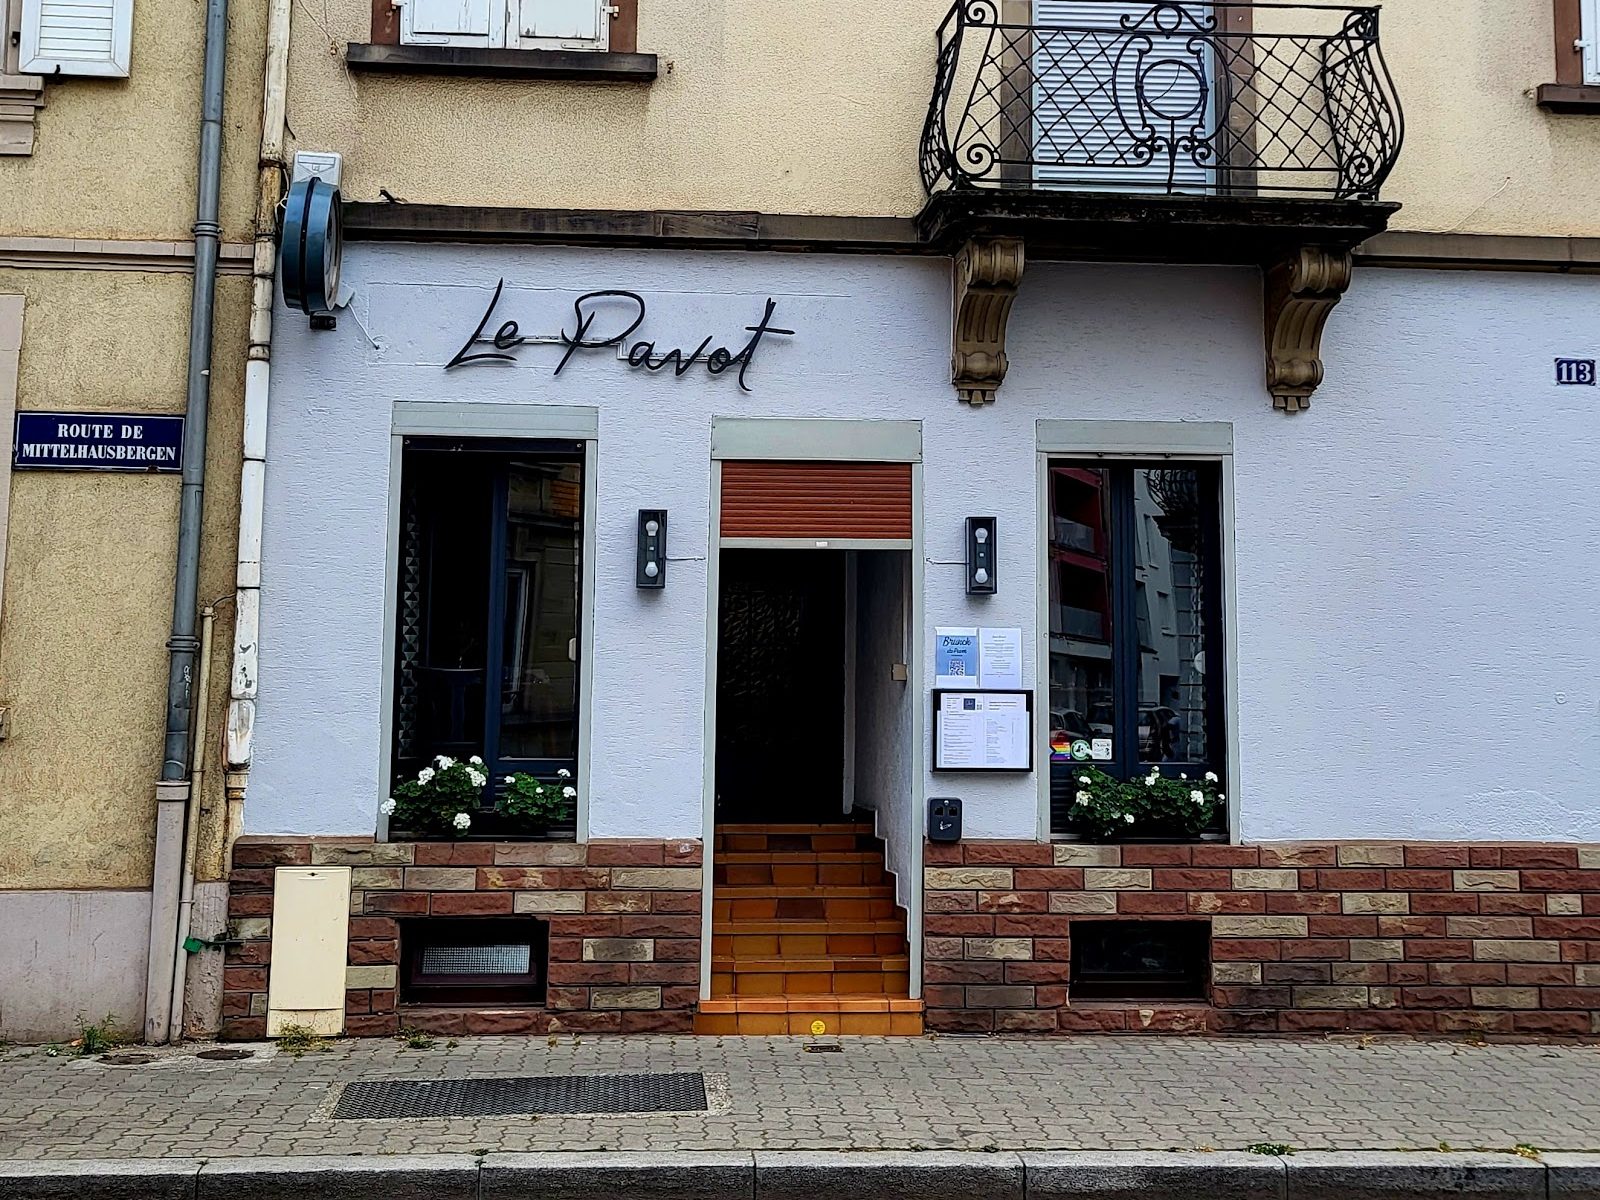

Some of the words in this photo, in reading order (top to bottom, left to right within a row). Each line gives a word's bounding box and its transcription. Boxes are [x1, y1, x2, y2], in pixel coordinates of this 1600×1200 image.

[443, 277, 525, 370] Le
[554, 290, 796, 392] Pavot
[1558, 362, 1592, 383] 113
[57, 423, 114, 439] ROUTE
[120, 424, 144, 440] DE
[22, 443, 177, 461] MITTELHAUSBERGEN
[942, 636, 972, 647] Brunch
